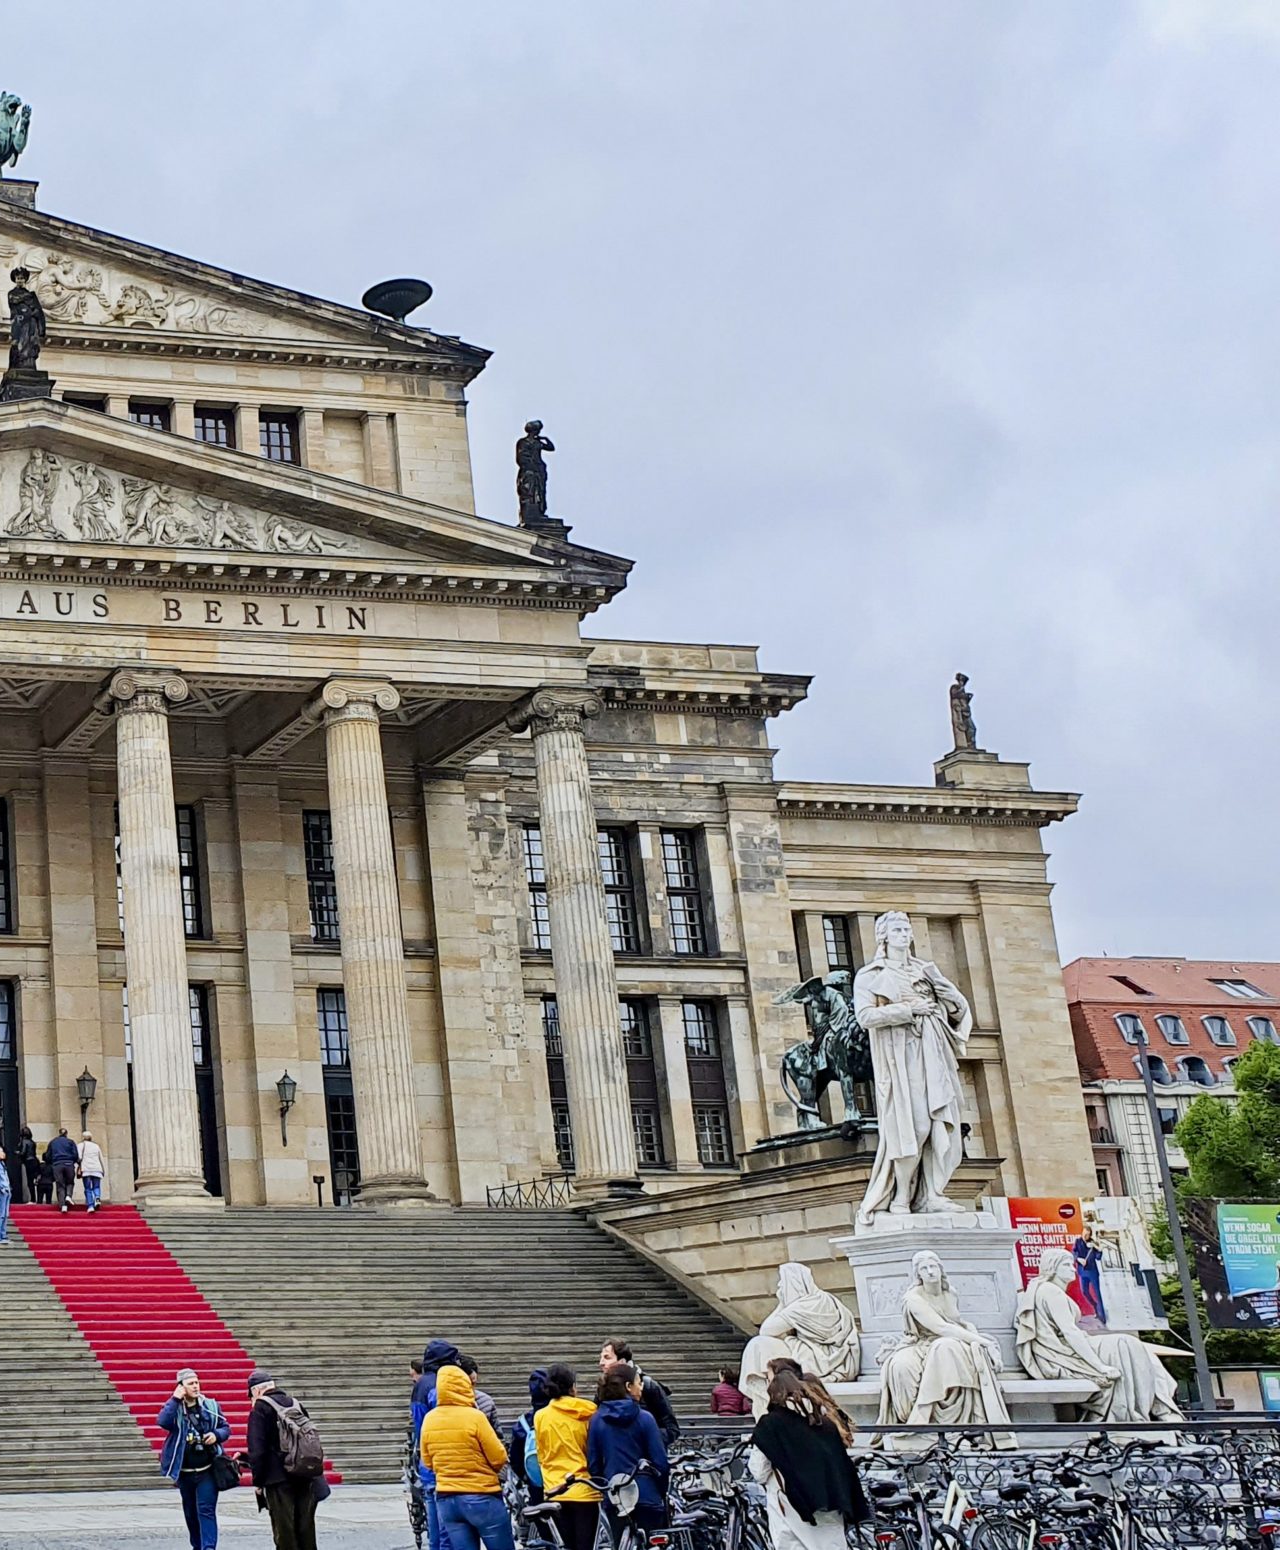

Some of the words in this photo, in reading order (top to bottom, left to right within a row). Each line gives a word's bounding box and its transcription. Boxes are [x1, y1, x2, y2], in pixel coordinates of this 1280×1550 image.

[162, 597, 369, 633] BERLIN
[1040, 1223, 1067, 1233] HINTER
[1223, 1223, 1246, 1232] WENN
[1247, 1223, 1271, 1232] SOGAR
[1044, 1234, 1066, 1244] SAITE
[1225, 1234, 1237, 1244] DIE
[1238, 1234, 1261, 1244] ORGEL
[1226, 1244, 1252, 1254] STROM
